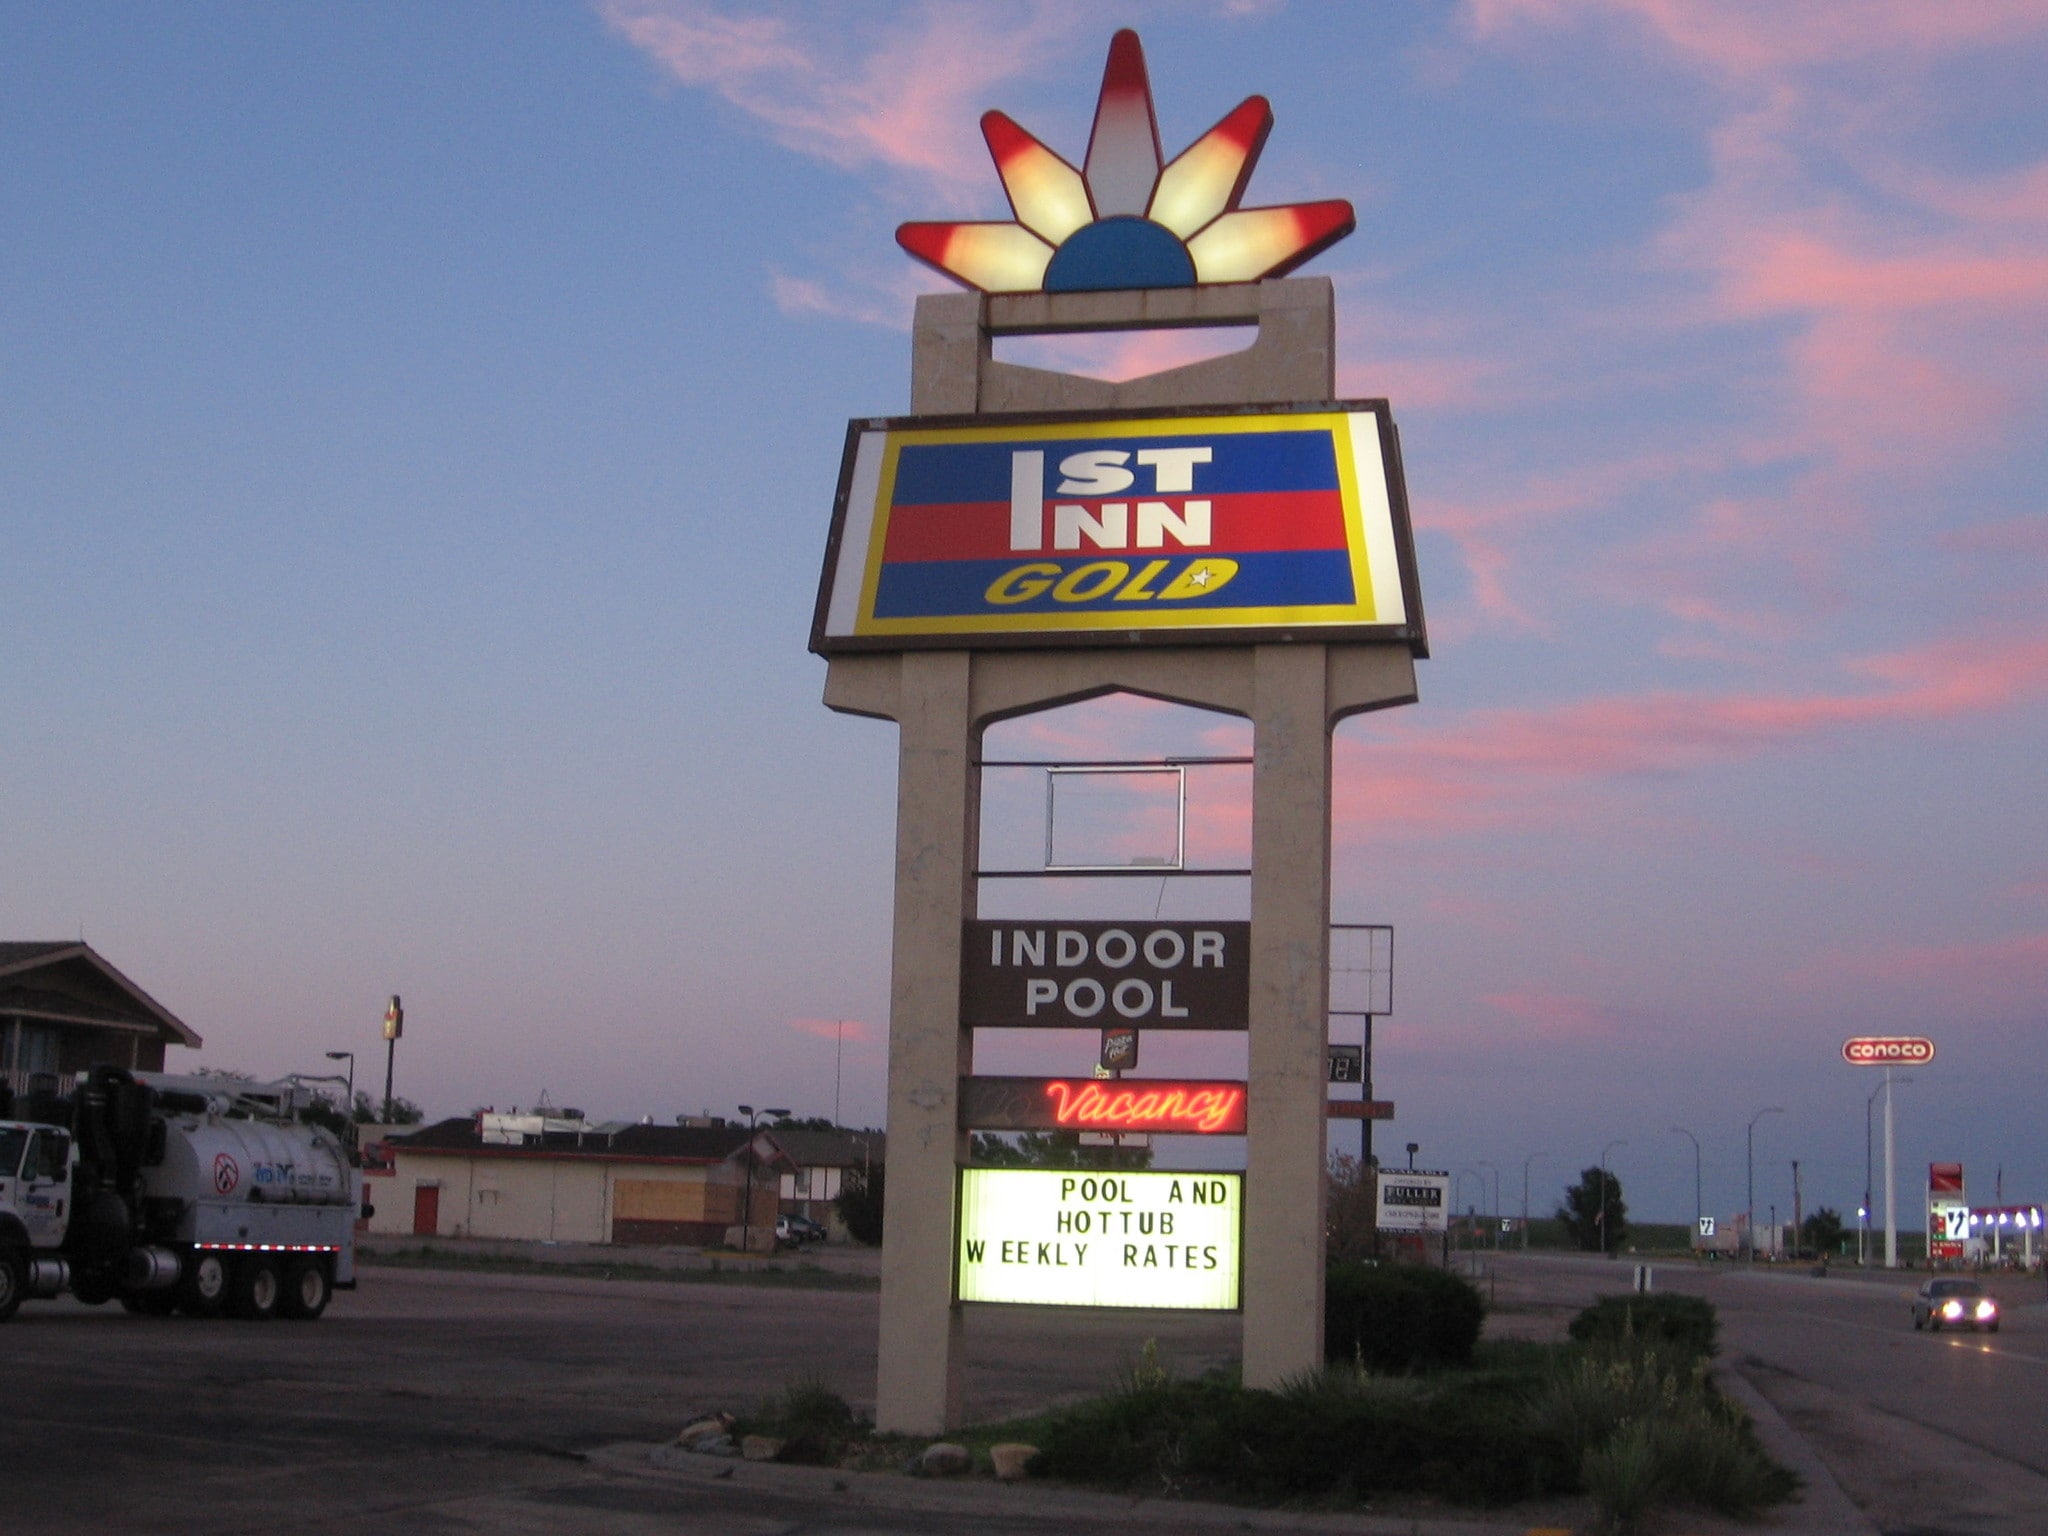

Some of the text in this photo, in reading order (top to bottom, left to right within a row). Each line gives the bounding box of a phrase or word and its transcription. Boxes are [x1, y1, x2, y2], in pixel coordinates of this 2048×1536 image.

[984, 558, 1240, 605] GOLD
[991, 929, 1226, 969] INDOOR
[1026, 977, 1189, 1018] POOL
[1047, 1081, 1241, 1132] Vacancy
[1062, 1178, 1227, 1205] POOL AND
[966, 1239, 1218, 1269] WEEKLY RATES
